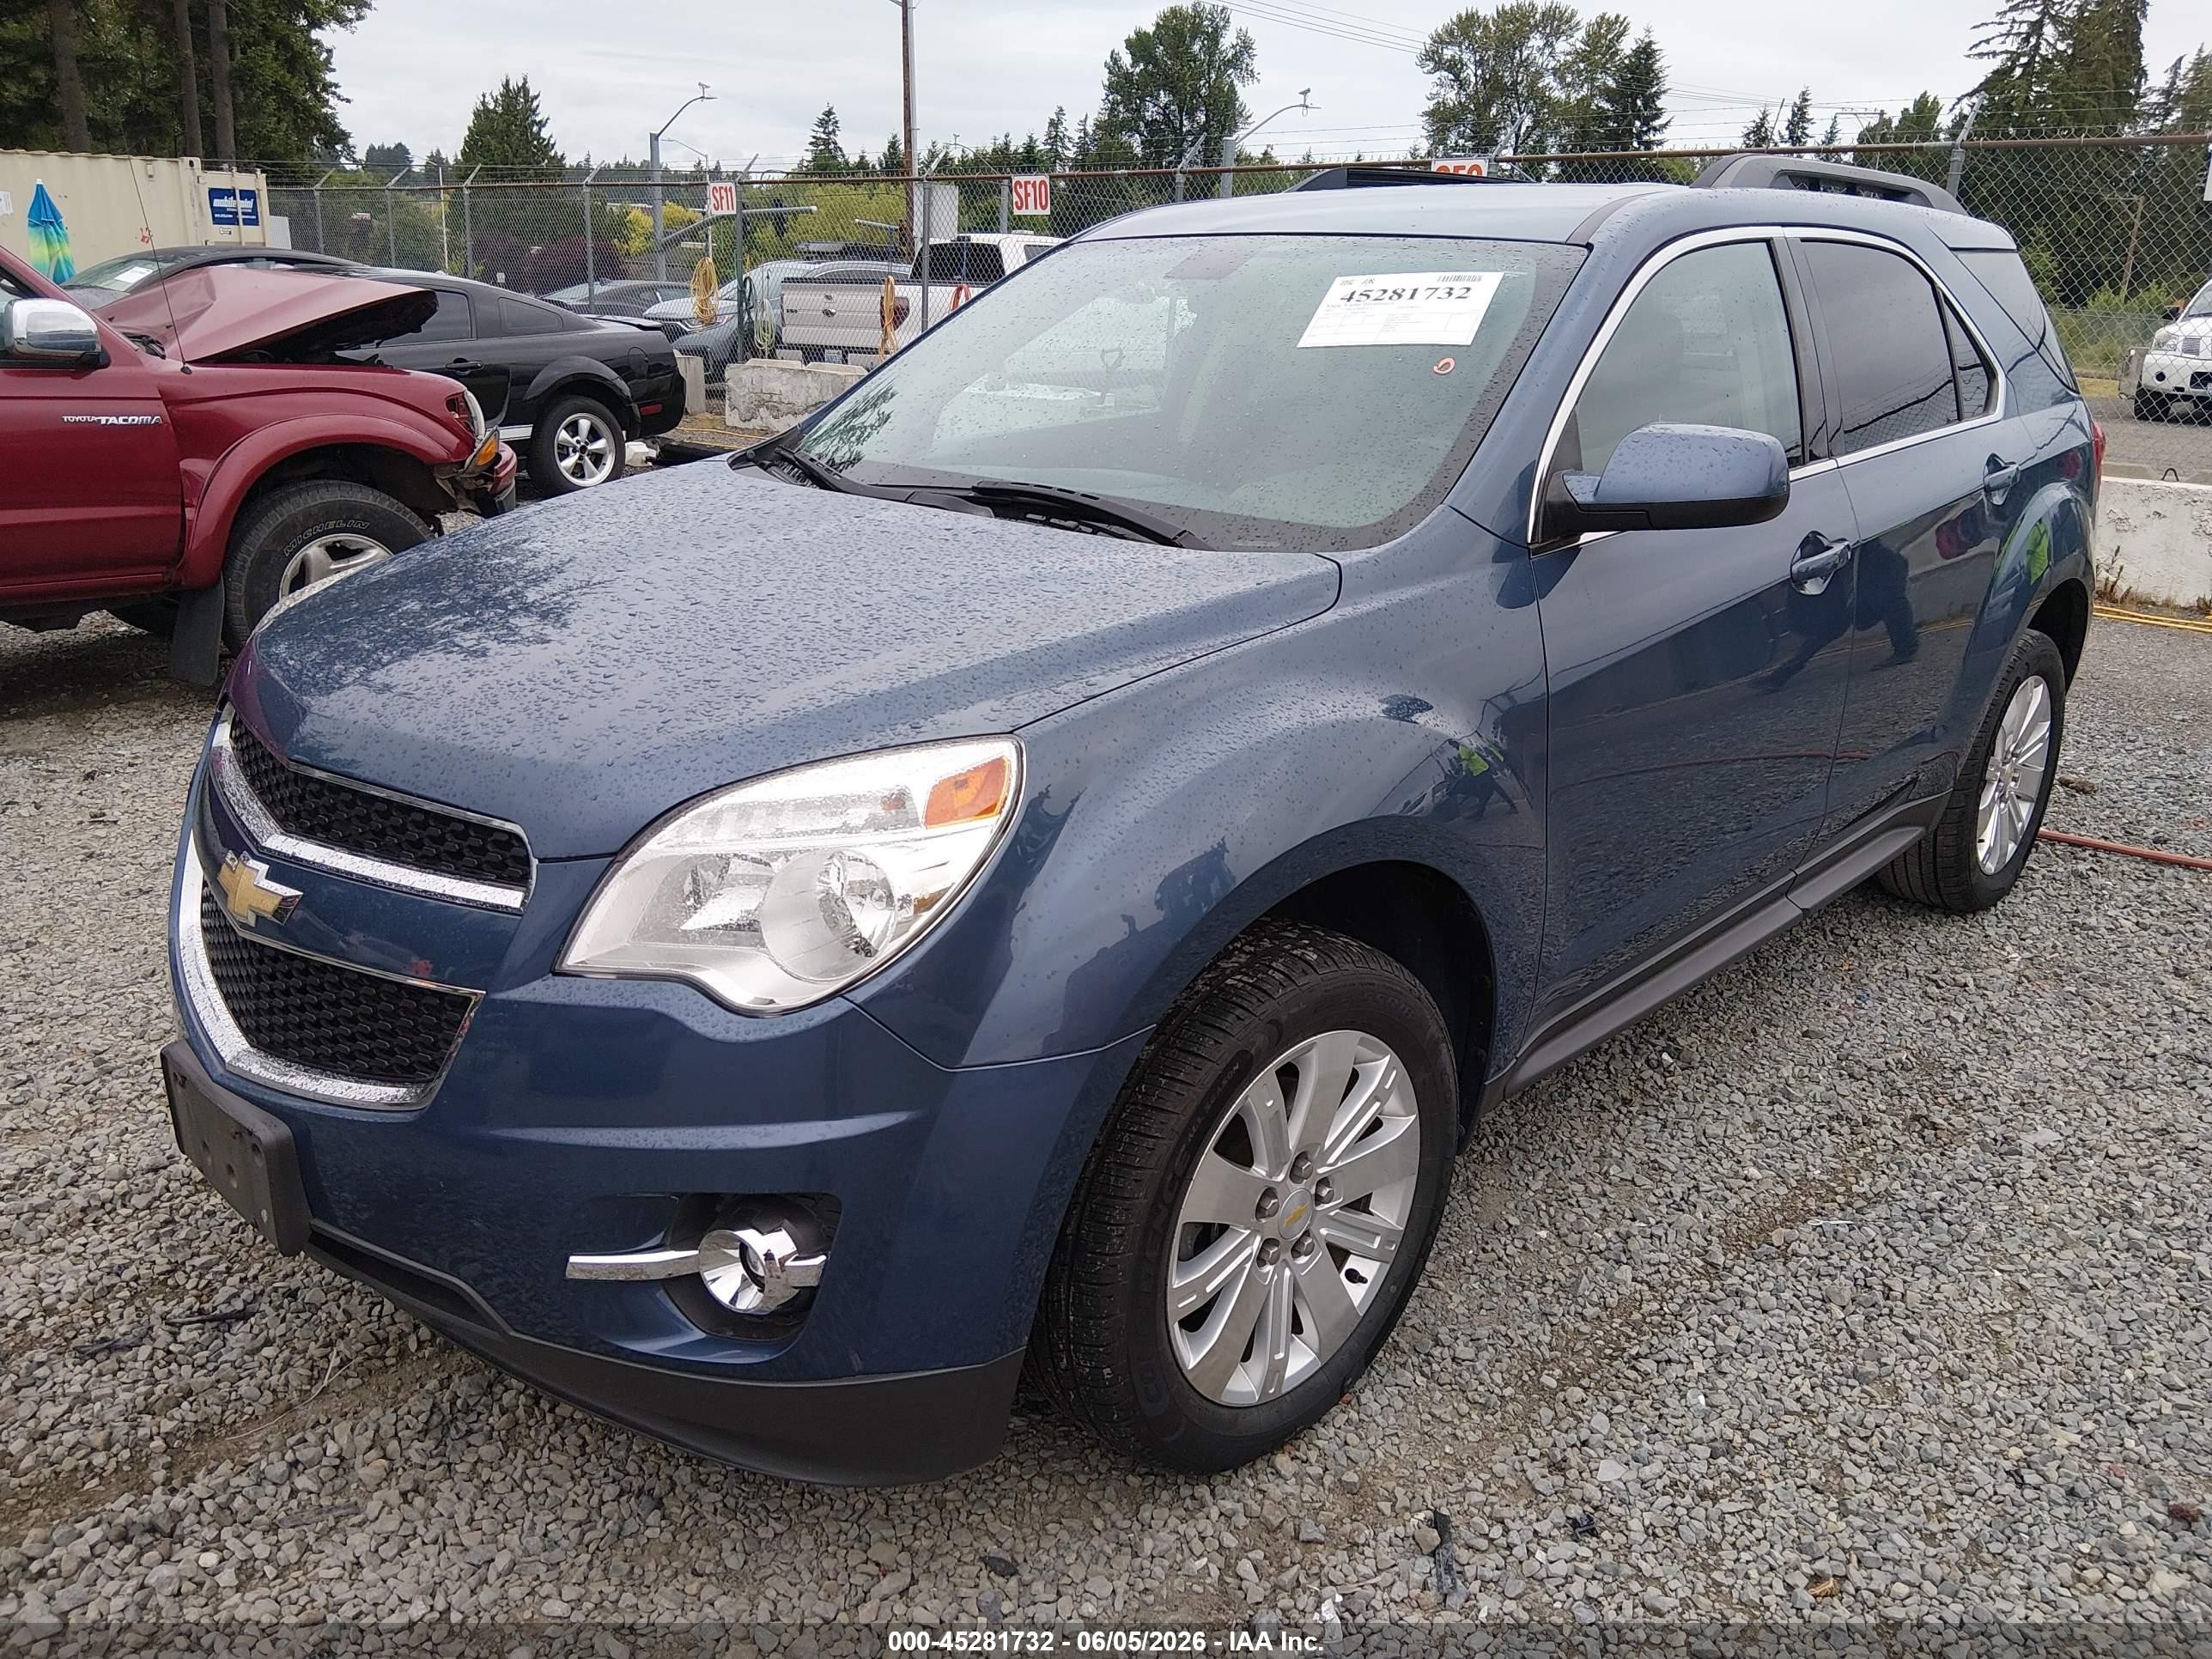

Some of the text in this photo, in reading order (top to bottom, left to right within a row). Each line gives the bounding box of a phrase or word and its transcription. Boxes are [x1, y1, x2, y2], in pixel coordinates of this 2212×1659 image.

[712, 185, 734, 211] SF11
[1014, 179, 1048, 211] SF10
[1340, 287, 1473, 302] 45281732
[96, 416, 163, 426] TACOMA
[283, 520, 370, 557] MICHELIN
